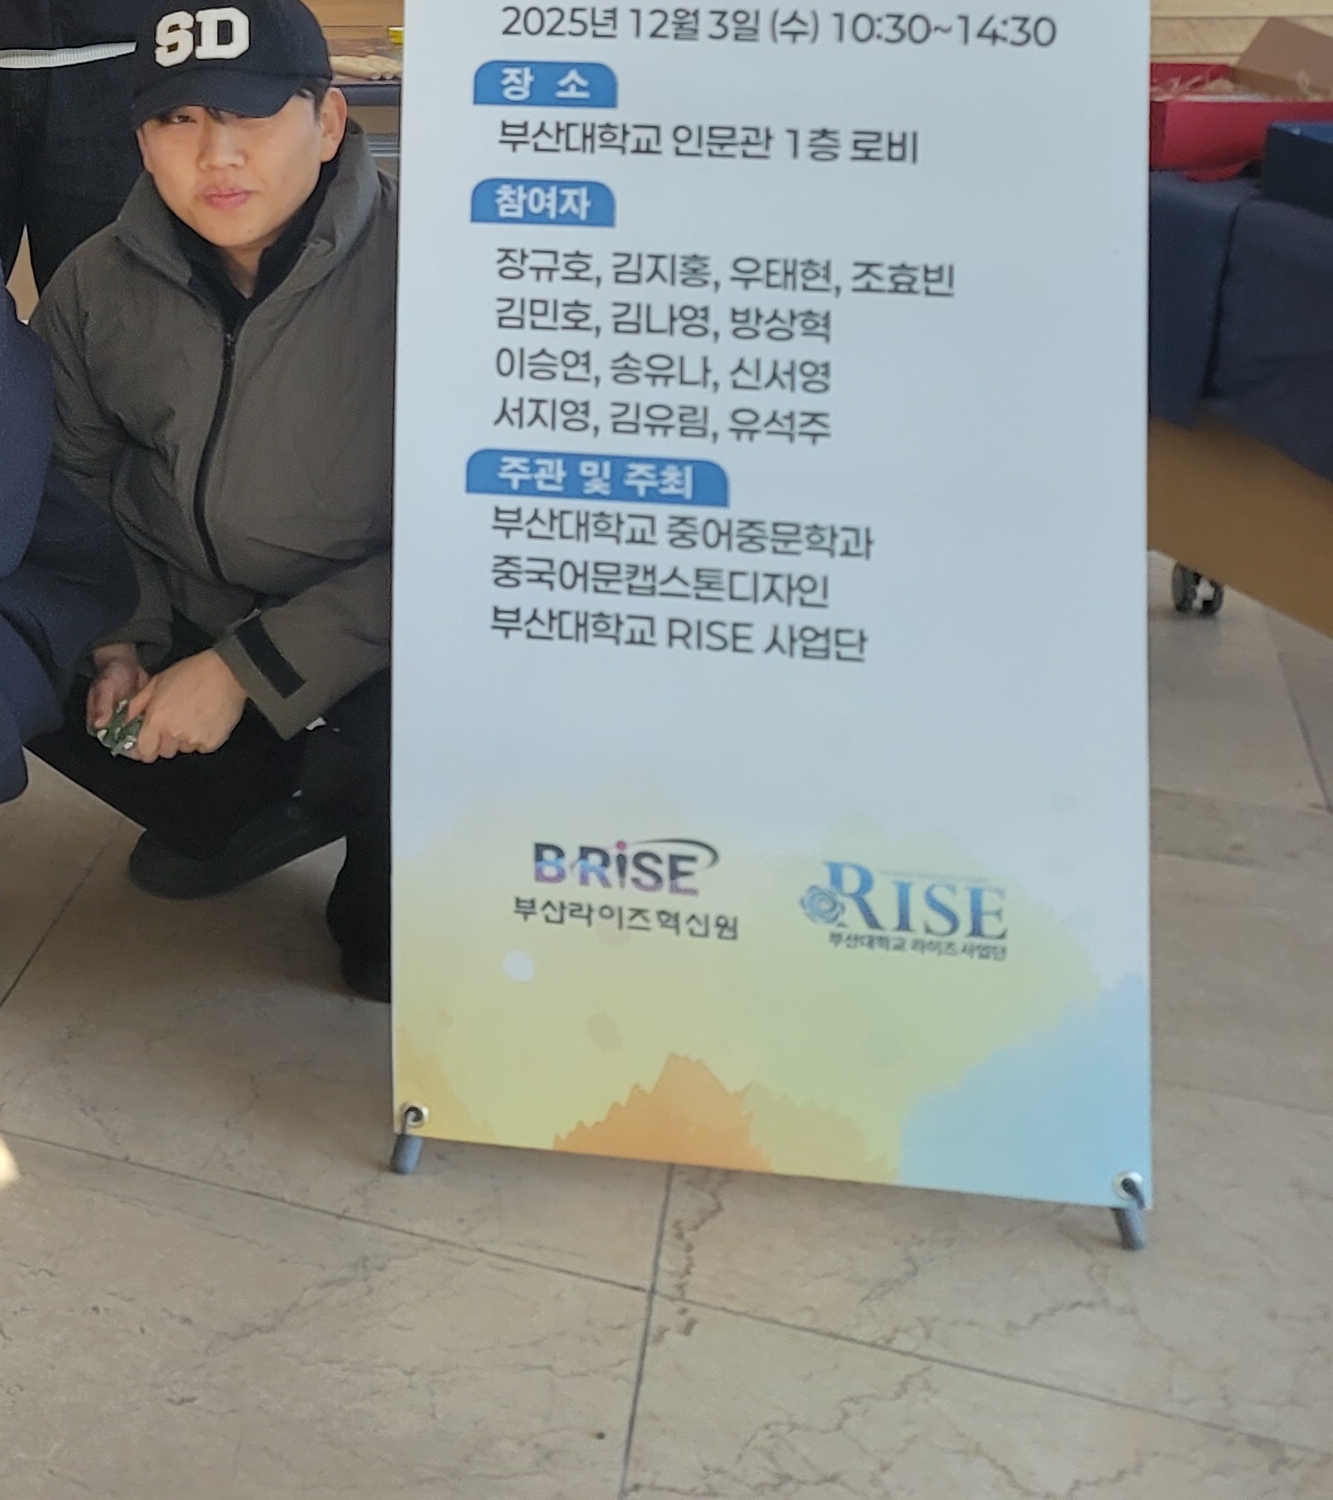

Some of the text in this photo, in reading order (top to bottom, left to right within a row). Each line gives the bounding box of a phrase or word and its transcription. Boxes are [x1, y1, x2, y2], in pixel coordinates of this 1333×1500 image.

[155, 6, 250, 68] SD
[502, 6, 1056, 47] 2025년 12월 3일 (수) 10:30~14:30
[502, 68, 589, 100] 장 소
[499, 121, 917, 164] 부산대학교 인문관 1층 로비
[495, 183, 590, 221] 참여자
[497, 248, 954, 297] 장규호, 김지홍, 우태현, 조효빈
[497, 298, 830, 343] 김민호, 김나영, 방상혁
[496, 348, 830, 394] 이승연, 송유나, 신서영
[494, 397, 830, 445] 서지영, 김유림, 유석주
[498, 457, 693, 500] 주관 및 주최
[492, 505, 874, 560] 부산대학교 중어중문학과
[492, 556, 830, 609] 중국어문캡스톤디자인
[491, 606, 868, 662] 부산대학교 RISE 사업단
[514, 896, 738, 940] 부산라이즈혁신원
[823, 860, 1008, 940] RISE
[829, 932, 906, 952] 부산대학교
[962, 942, 1007, 961] 사업단
